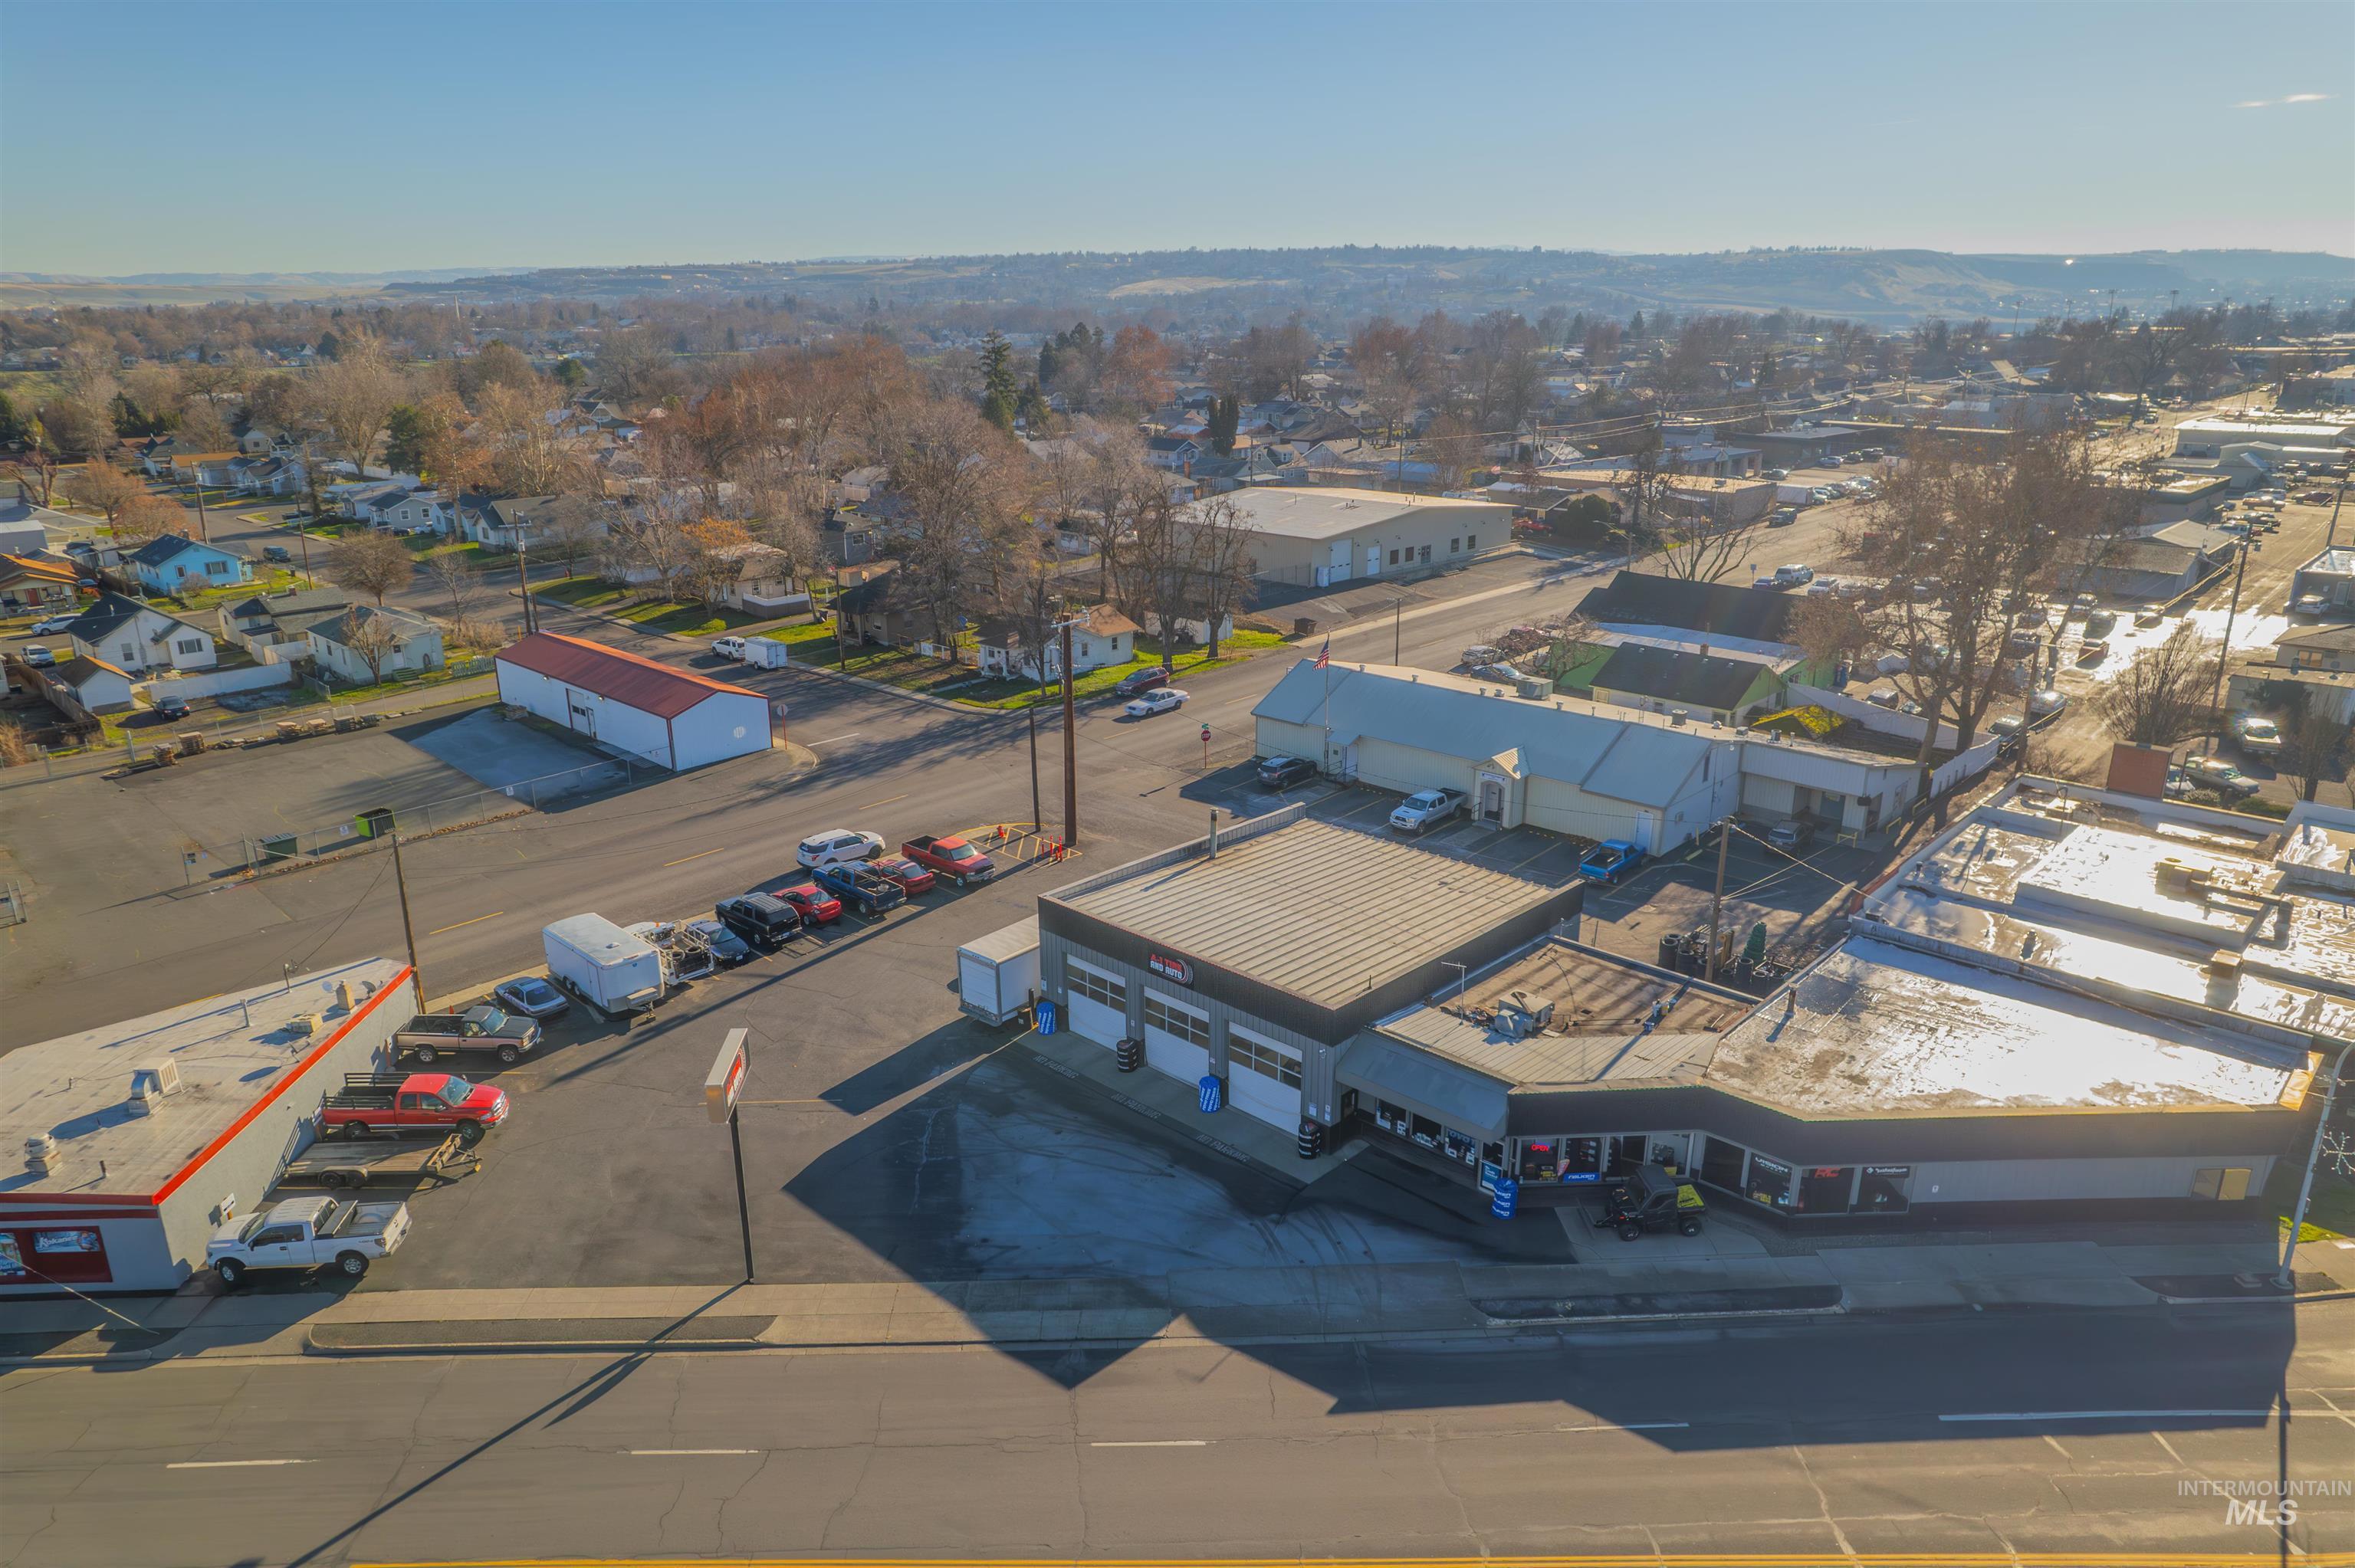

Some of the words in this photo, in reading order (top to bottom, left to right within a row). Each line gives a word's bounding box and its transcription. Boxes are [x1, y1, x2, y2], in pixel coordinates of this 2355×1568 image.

[1150, 960, 1164, 972] AND
[1165, 966, 1182, 979] AUTO
[1755, 1156, 1788, 1173] VISION
[38, 1235, 79, 1248] Kokanee
